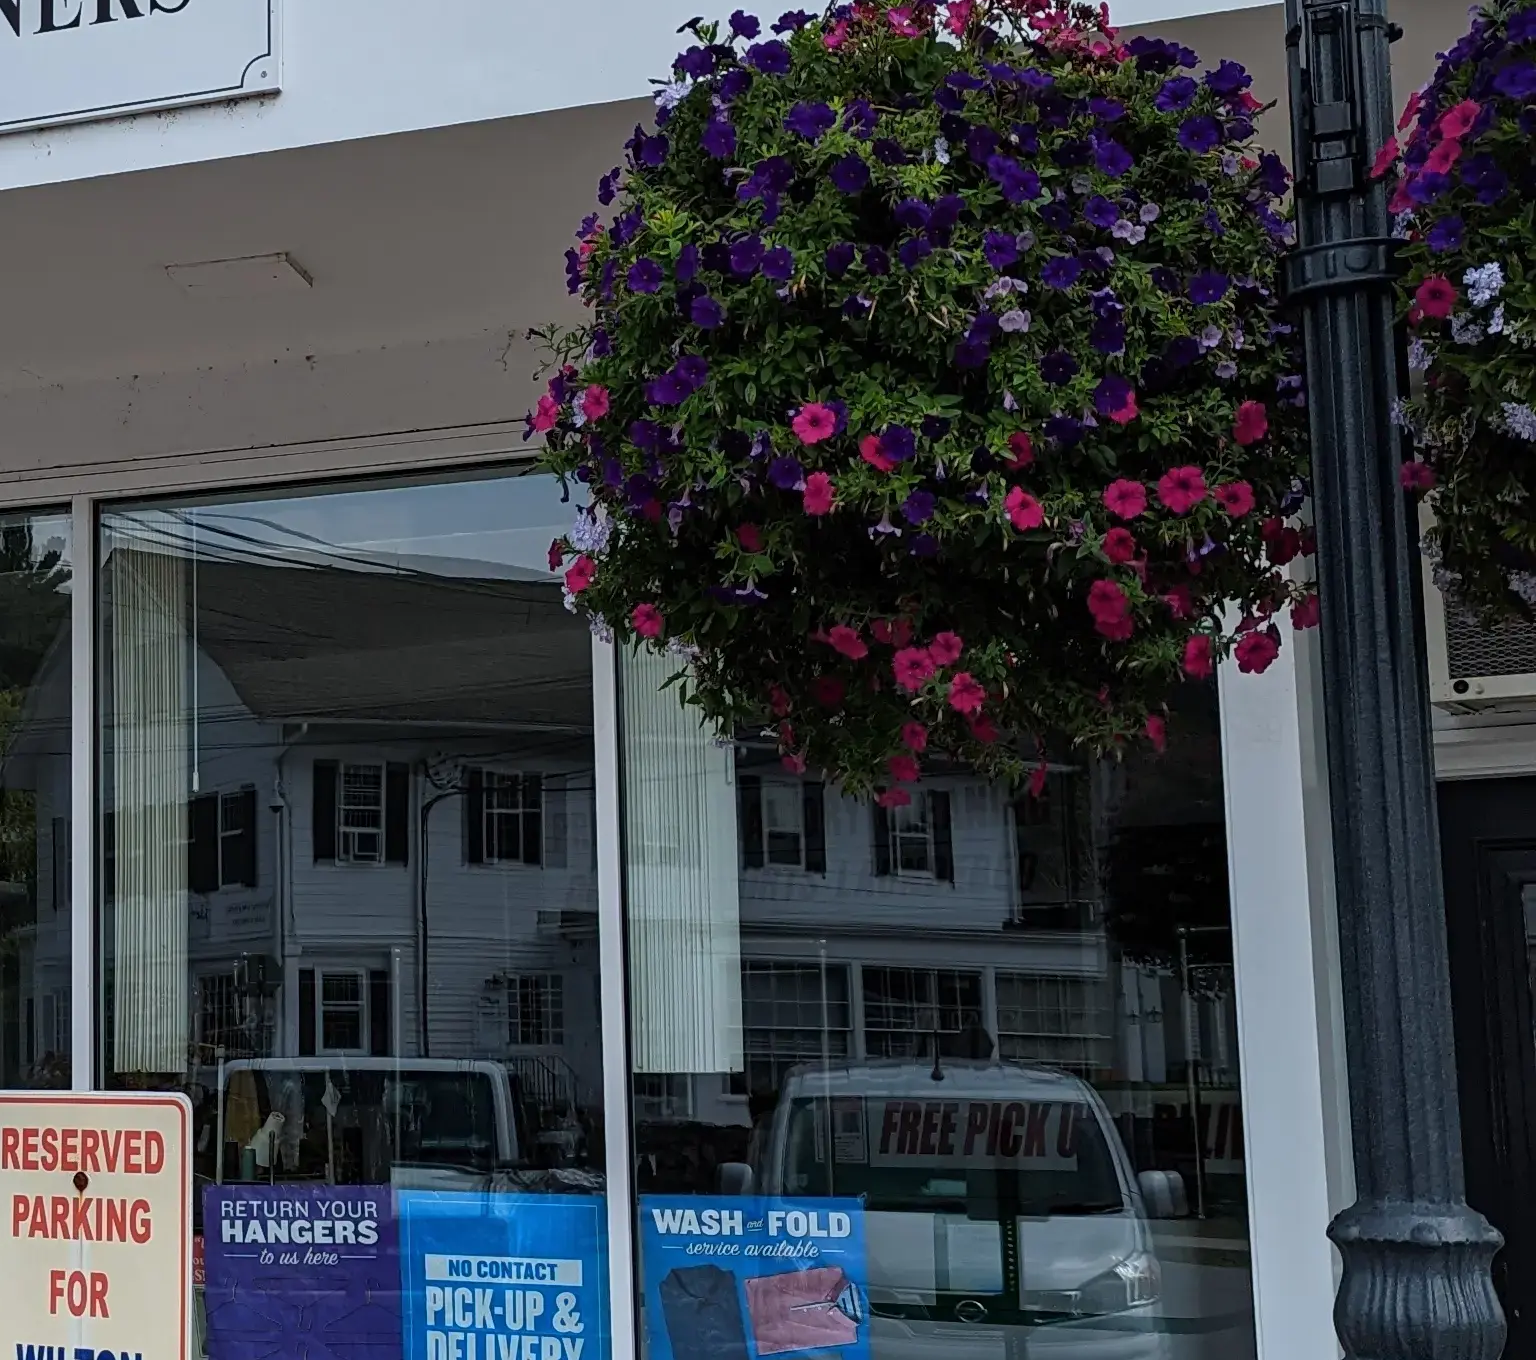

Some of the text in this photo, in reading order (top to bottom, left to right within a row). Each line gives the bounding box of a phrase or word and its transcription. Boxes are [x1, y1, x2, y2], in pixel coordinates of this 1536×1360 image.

[879, 1102, 959, 1155] FREE
[964, 1102, 1052, 1157] PICK
[1, 1127, 164, 1174] RESERVED
[12, 1194, 152, 1244] PARKING
[221, 1201, 377, 1218] RETURN YOUR
[652, 1208, 744, 1236] WASH
[768, 1211, 851, 1238] FOLD
[221, 1220, 378, 1244] HANGERS
[260, 1249, 339, 1266] to us here
[685, 1240, 819, 1259] service available
[448, 1260, 558, 1281] NO CONTACT
[49, 1270, 109, 1318] FOR
[426, 1286, 584, 1334] PICK-UP &
